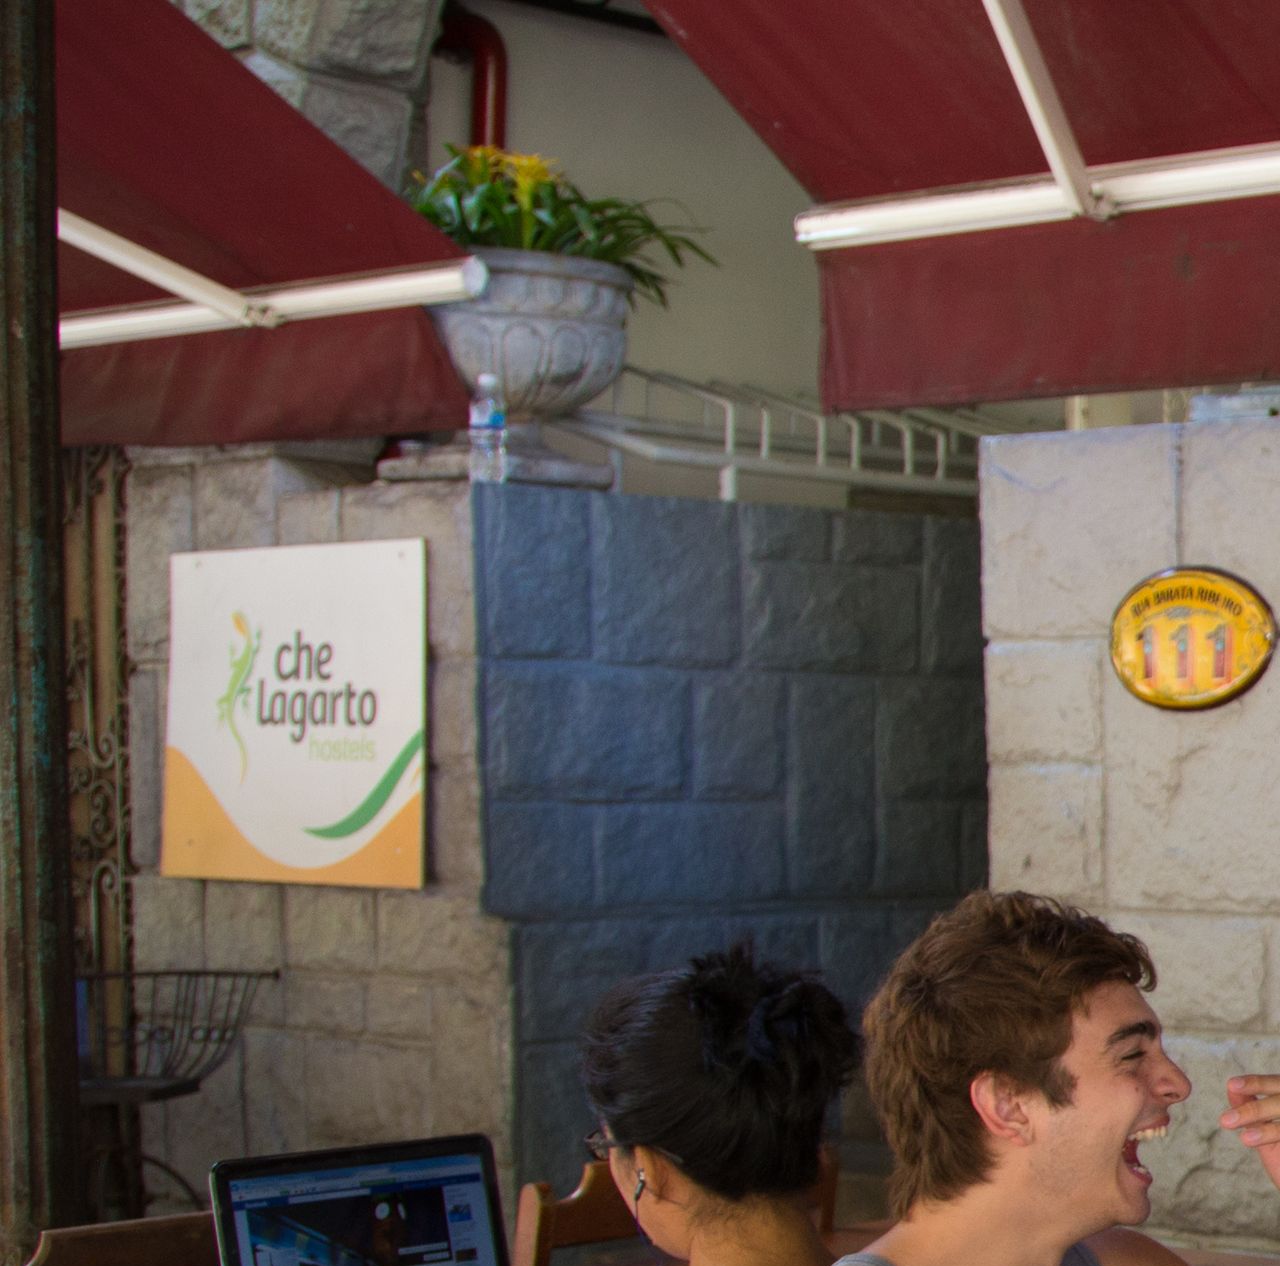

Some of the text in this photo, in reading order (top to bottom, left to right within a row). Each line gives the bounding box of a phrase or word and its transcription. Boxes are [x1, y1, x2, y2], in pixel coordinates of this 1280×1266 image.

[276, 630, 334, 682] che
[1135, 623, 1231, 681] 111
[309, 733, 376, 762] hostels
